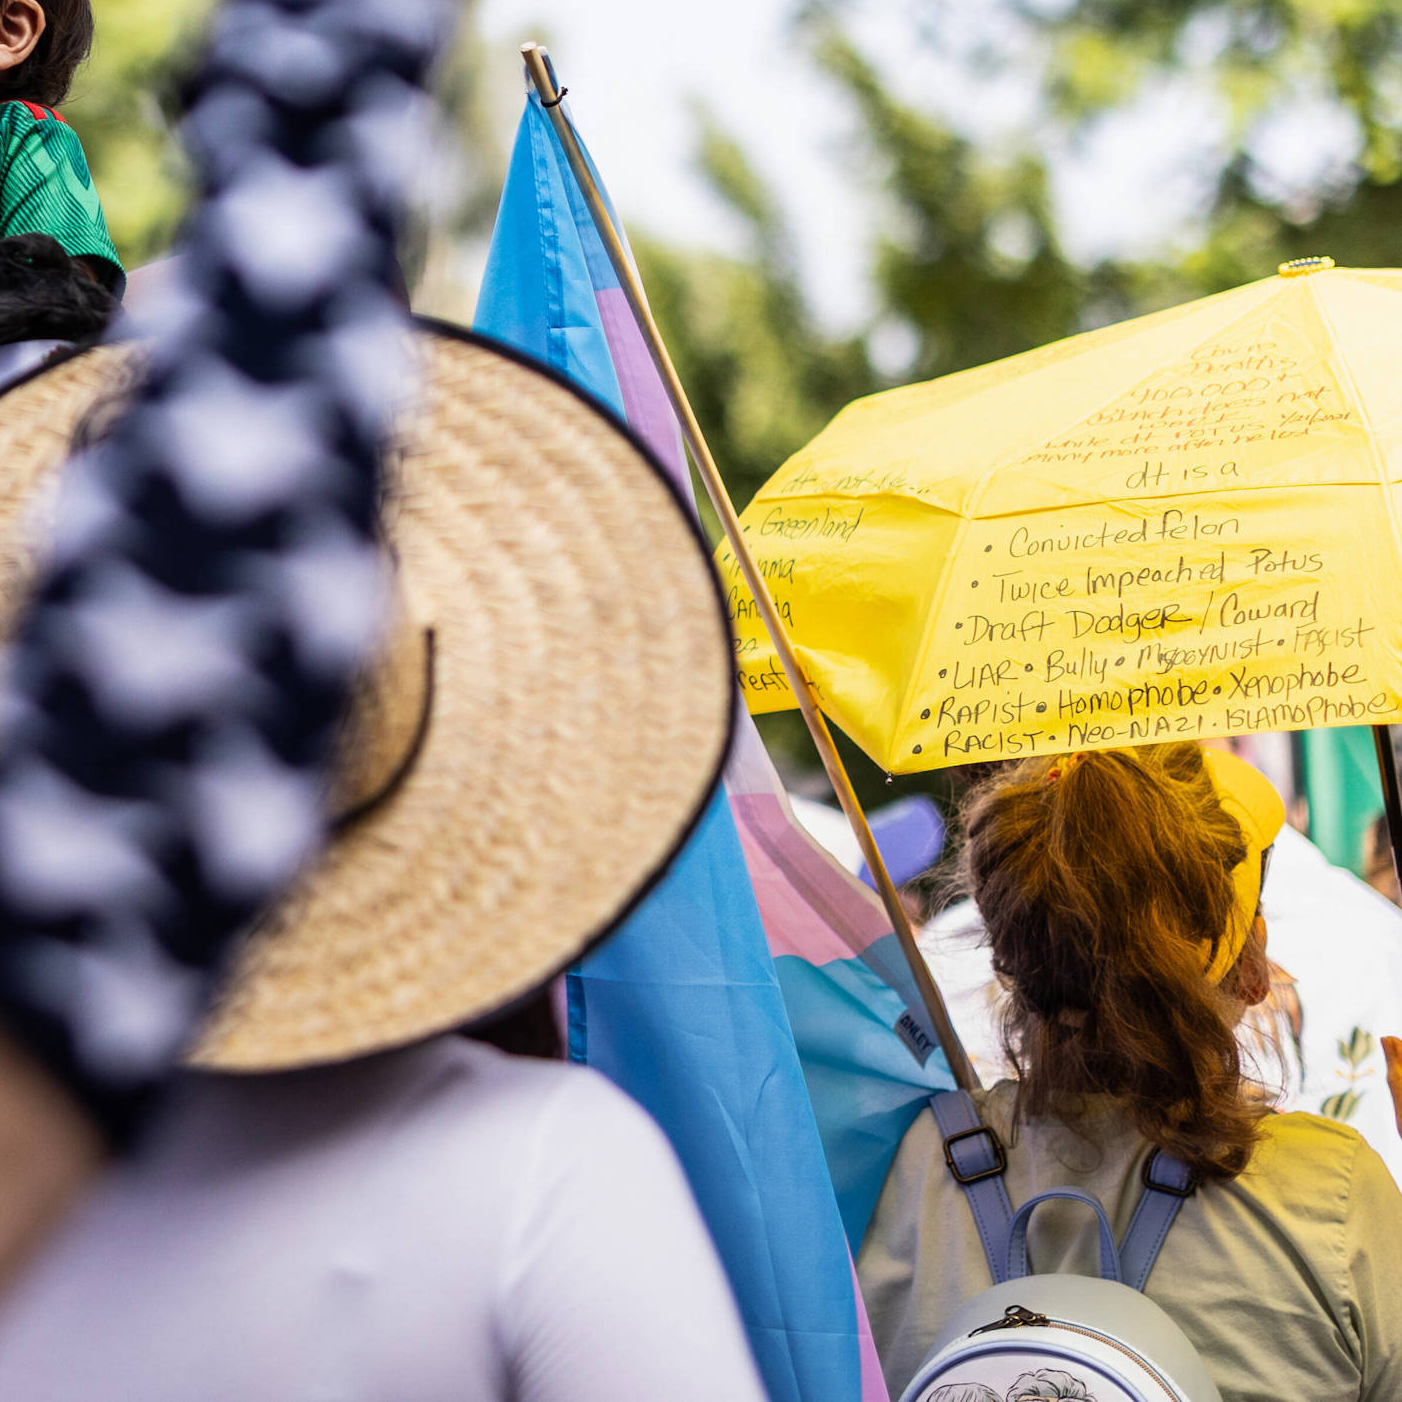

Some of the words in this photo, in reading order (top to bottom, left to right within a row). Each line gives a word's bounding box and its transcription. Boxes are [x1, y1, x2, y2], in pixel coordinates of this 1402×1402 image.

[1125, 461, 1172, 489] dt
[1182, 462, 1208, 480] is
[1219, 460, 1240, 477] a
[1009, 518, 1148, 558] Convicted
[992, 569, 1077, 604] Twice
[1086, 550, 1226, 599] Impeached
[1246, 548, 1324, 575] Potus
[964, 609, 1056, 646] Draft
[1220, 590, 1320, 628] Coward
[953, 660, 1019, 690] LIAR
[1044, 647, 1108, 684] Bully
[1059, 679, 1213, 721] Homophobe
[1227, 661, 1368, 702] Xenophobe
[944, 729, 1045, 757] RACIST
